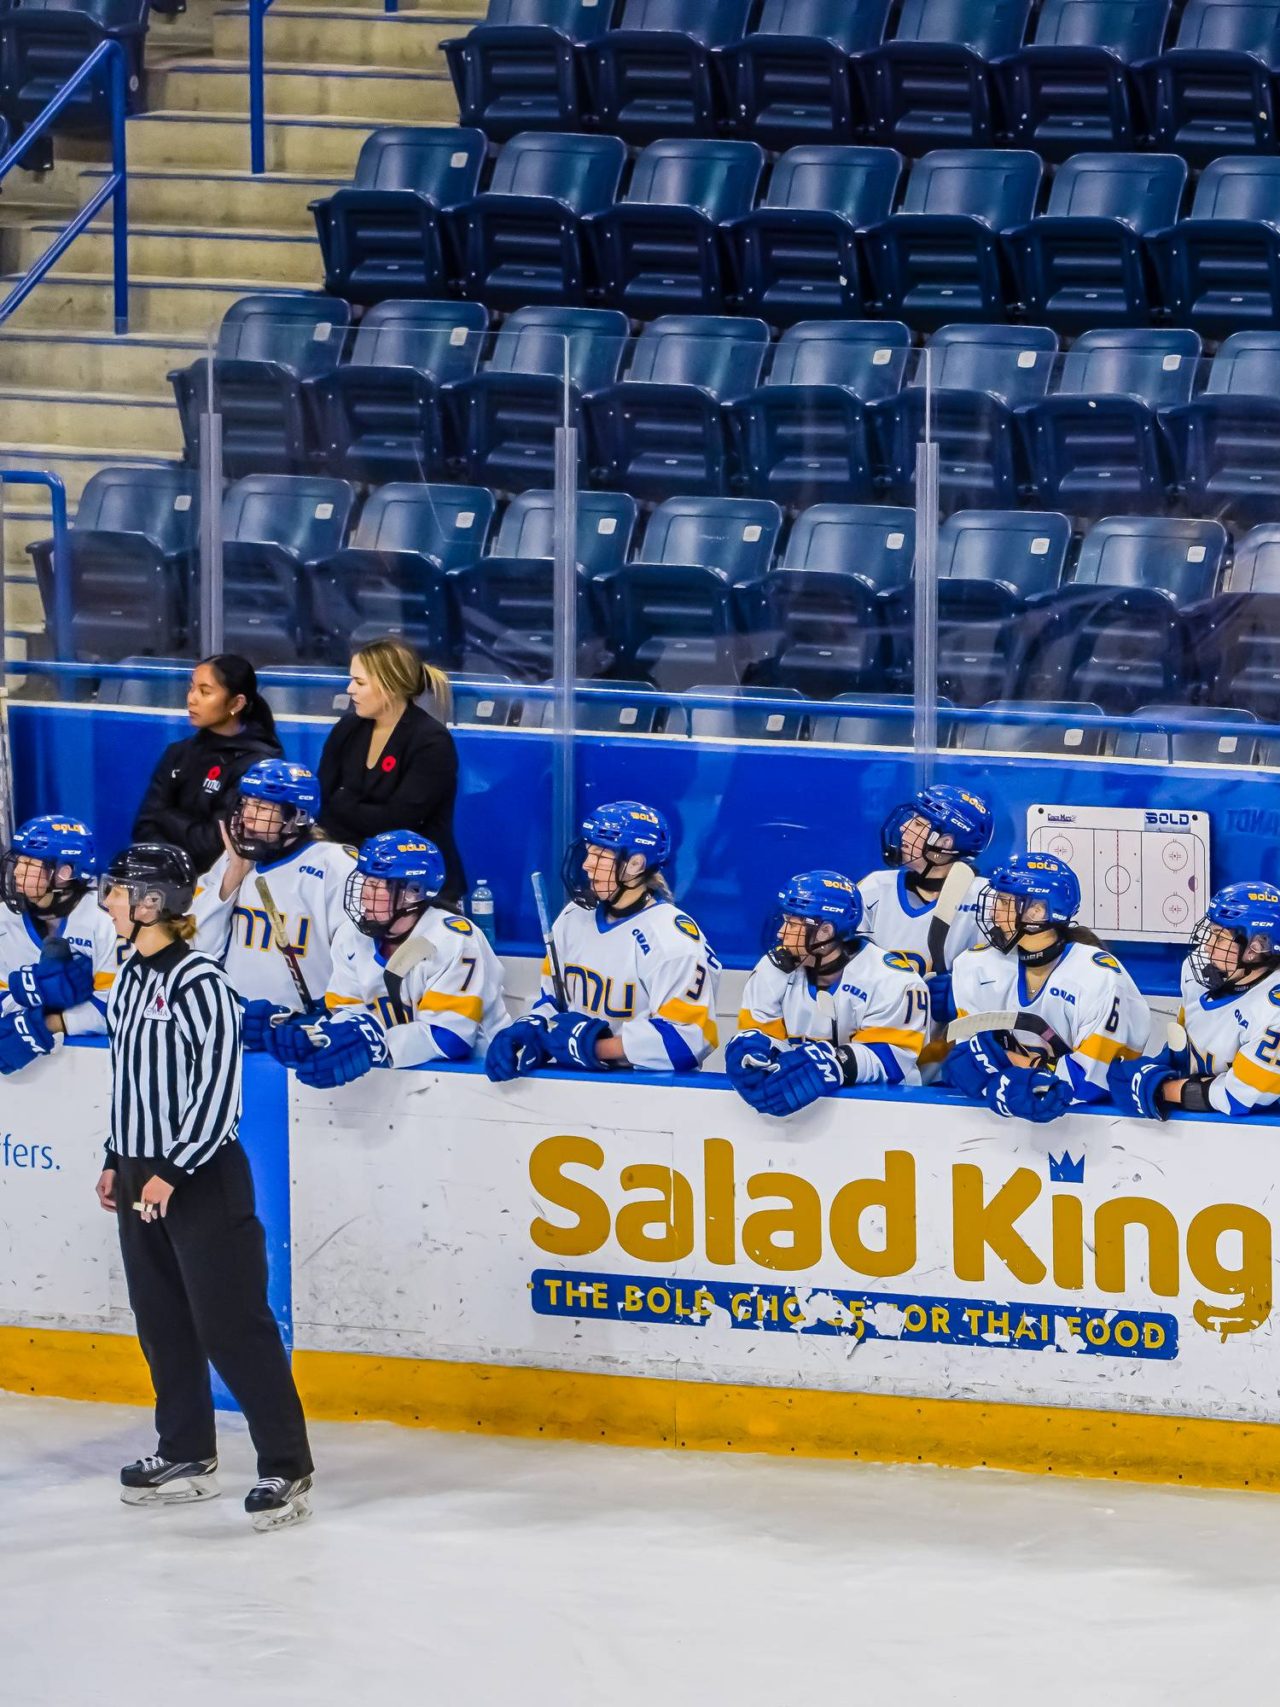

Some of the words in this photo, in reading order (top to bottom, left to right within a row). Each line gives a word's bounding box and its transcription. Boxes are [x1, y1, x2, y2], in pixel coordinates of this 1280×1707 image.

[1145, 812, 1189, 825] BOLD
[299, 865, 324, 879] OUA
[822, 906, 845, 914] CCM
[231, 905, 312, 961] MU
[632, 928, 652, 957] OUA
[461, 957, 477, 992] 7
[562, 962, 637, 1022] MU
[685, 963, 707, 1002] 3
[841, 984, 867, 1002] OUA
[904, 990, 928, 1027] 14
[1050, 986, 1076, 1005] OUA
[13, 1009, 47, 1054] CM
[1106, 997, 1119, 1034] 6
[804, 1041, 838, 1083] CM
[969, 1035, 1000, 1078] CM
[0, 1132, 61, 1170] fers.
[529, 1134, 917, 1278] Salad
[951, 1150, 1273, 1342] King
[544, 1279, 608, 1309] THE
[731, 1292, 866, 1327] CHOE
[886, 1302, 951, 1334] OR
[965, 1308, 1049, 1341] THAI
[1067, 1316, 1166, 1349] FOOD
